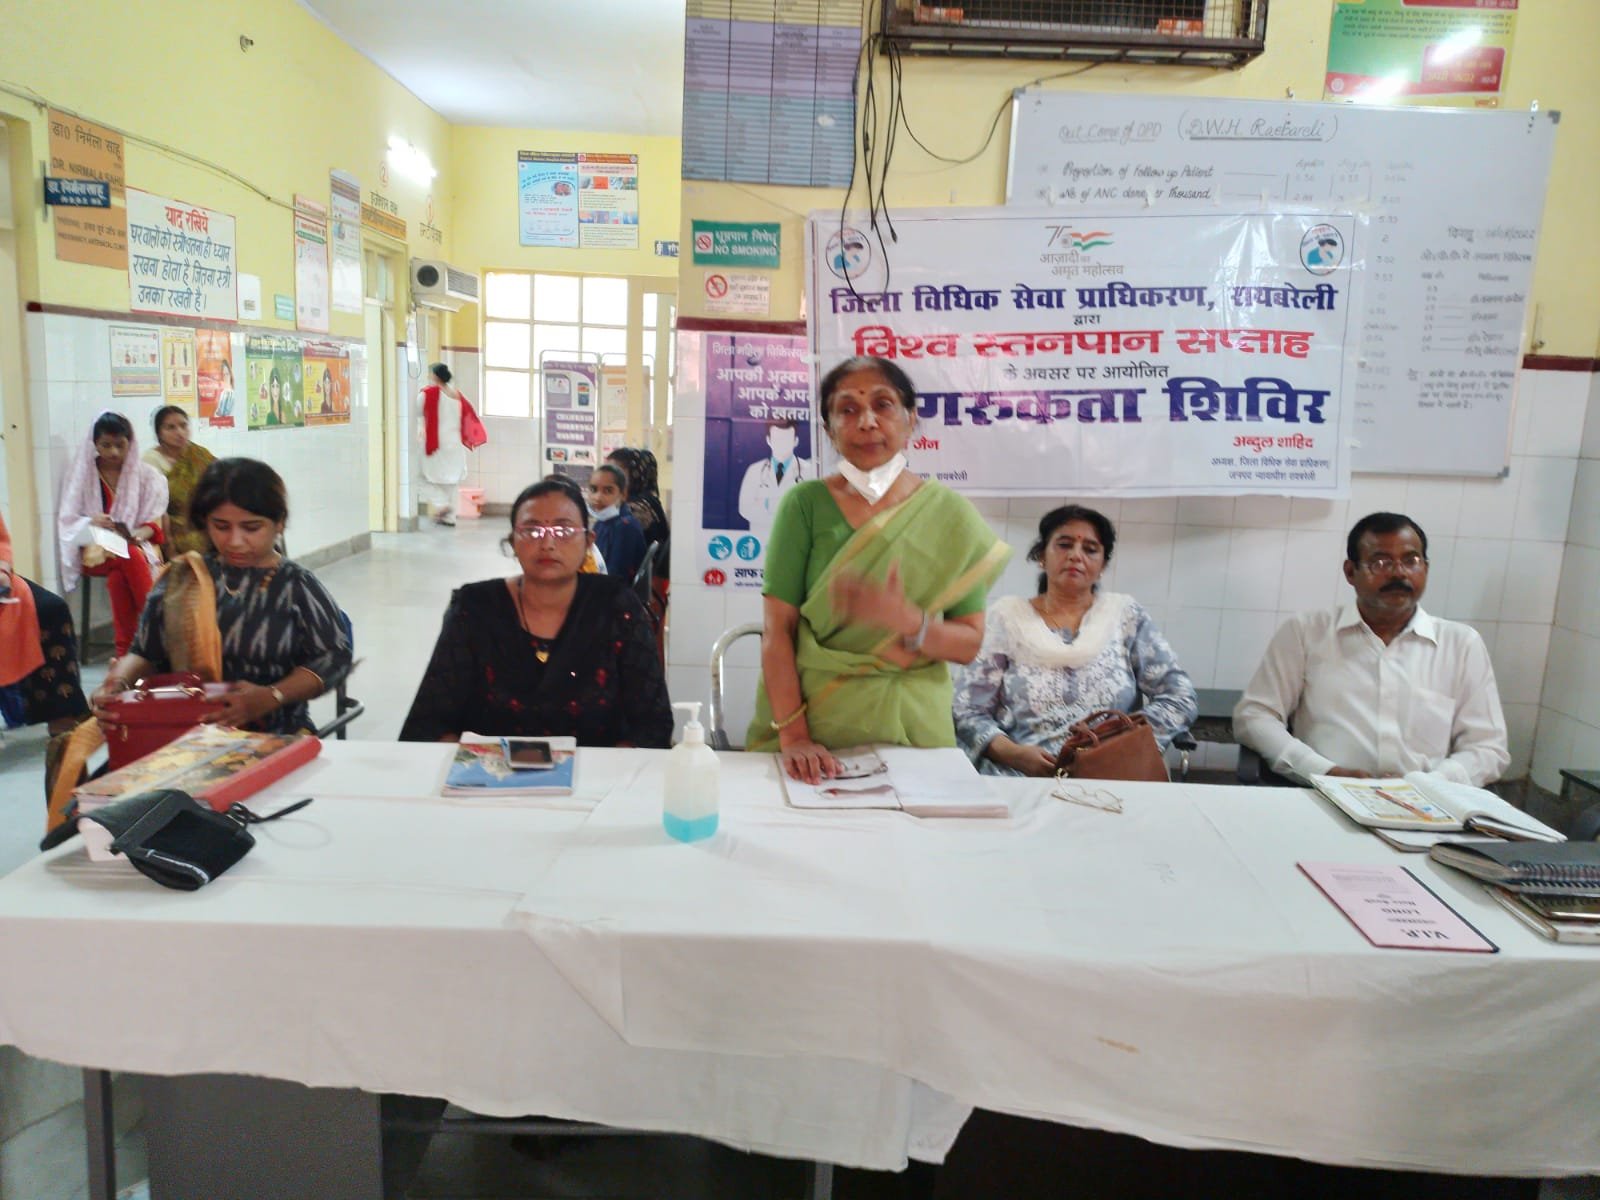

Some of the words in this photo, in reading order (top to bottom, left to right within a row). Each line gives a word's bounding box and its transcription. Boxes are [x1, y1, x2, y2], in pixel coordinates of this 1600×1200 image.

[165, 206, 183, 230] याद
[714, 245, 729, 255] NO
[731, 245, 778, 257] SMOKING
[133, 254, 160, 278] रखना
[162, 253, 182, 282] होता
[182, 257, 191, 287] है
[193, 260, 216, 288] जितना
[217, 265, 232, 288] स्त्री
[1051, 265, 1080, 280] अमृत
[1082, 261, 1125, 278] महोत्सव
[138, 285, 166, 305] उनका
[168, 286, 193, 310] रखती
[829, 287, 903, 314] जिला
[912, 284, 1002, 312] विधिक
[1011, 283, 1066, 310] सेवा
[1075, 281, 1214, 312] प्राधिकरण,
[1231, 282, 1339, 311] रायबरेली
[1073, 314, 1101, 326] द्वारा
[852, 325, 960, 360] विश्व
[973, 329, 1164, 357] स्तनपान
[1175, 329, 1315, 359] सप्ताह
[716, 365, 763, 382] आपकी
[1003, 363, 1017, 380] के
[1023, 366, 1071, 381] अवसर
[1076, 365, 1097, 380] पर
[1102, 360, 1170, 380] आयोजित
[738, 383, 779, 402] आपके
[1162, 377, 1331, 424] शिविर
[749, 401, 770, 419] को
[1233, 436, 1274, 453] अब्दुल
[1277, 432, 1313, 449] शाहिद
[734, 568, 759, 578] साफ
